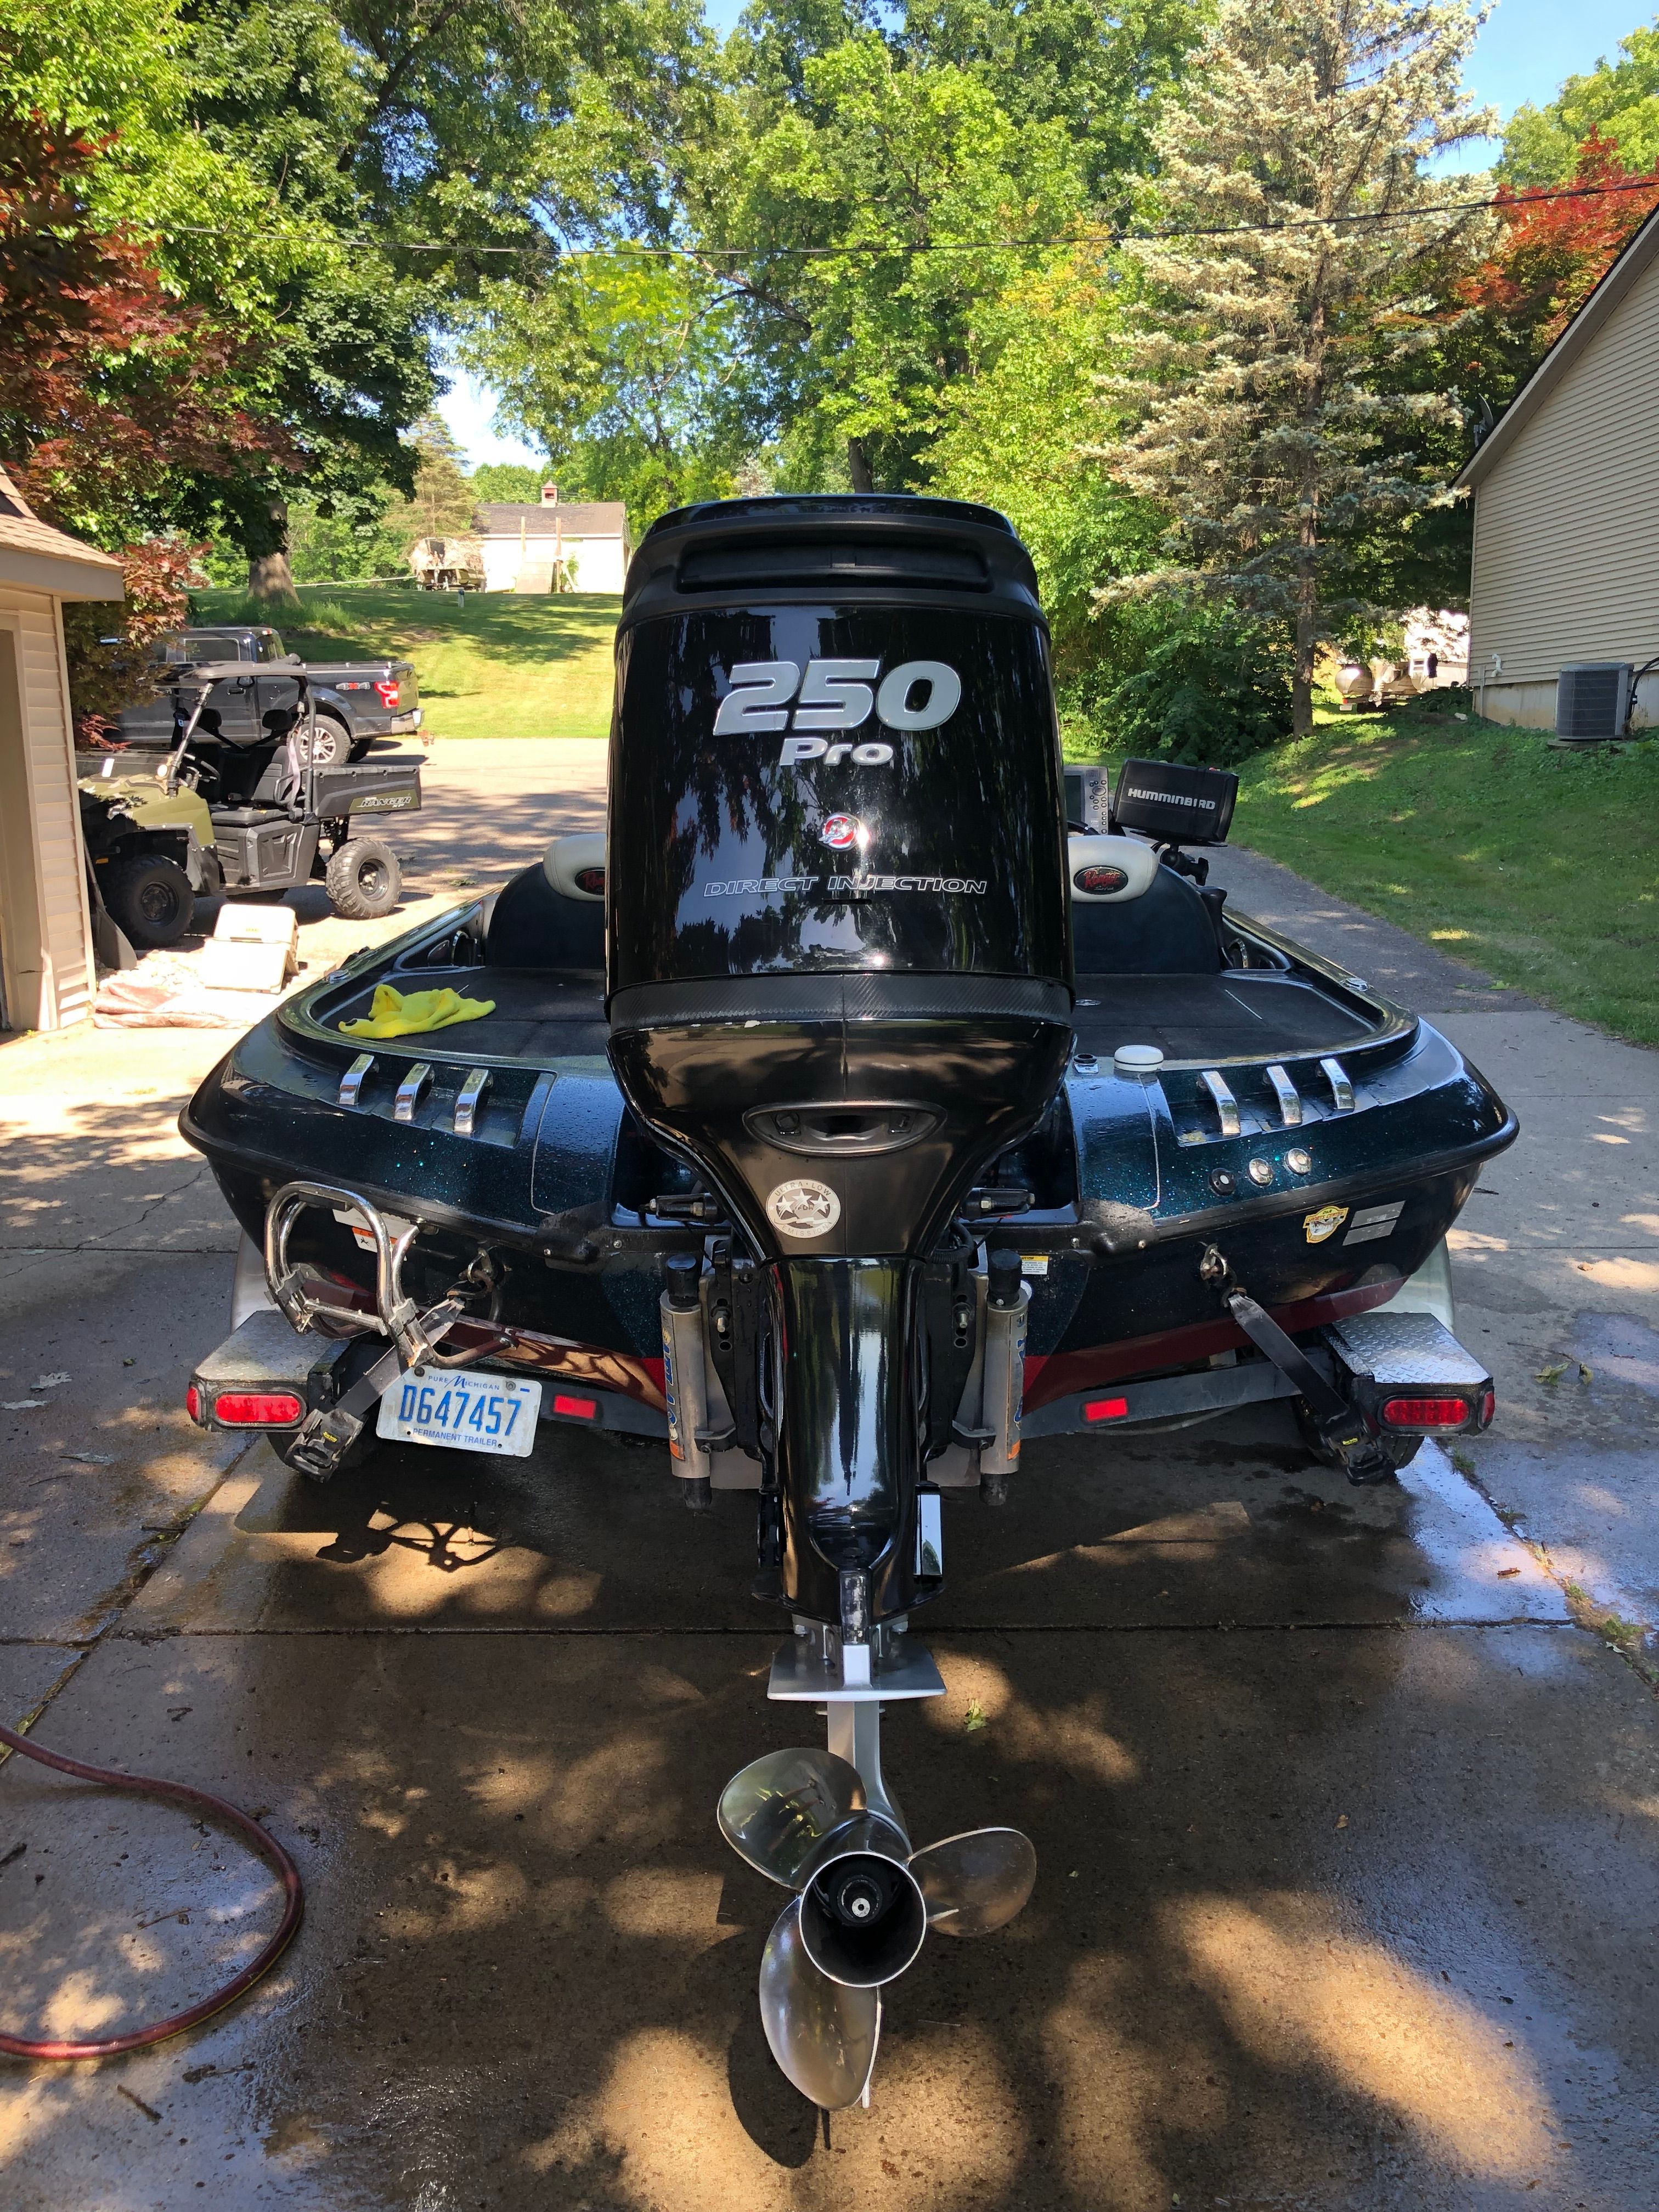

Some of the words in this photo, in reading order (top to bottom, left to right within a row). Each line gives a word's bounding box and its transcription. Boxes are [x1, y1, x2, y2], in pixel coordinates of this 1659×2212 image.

[713, 659, 962, 736] 250
[779, 737, 894, 766] Pro
[359, 797, 411, 807] RANGER
[1127, 788, 1215, 810] HUMMINBIRD
[703, 876, 819, 897] DIRECT
[827, 876, 988, 894] INJECTION
[428, 1375, 449, 1384] PURE
[444, 1375, 500, 1390] MICHIGAN
[398, 1384, 522, 1436] D647457
[413, 1428, 462, 1442] PERMANENT
[464, 1435, 498, 1447] TRAILER
